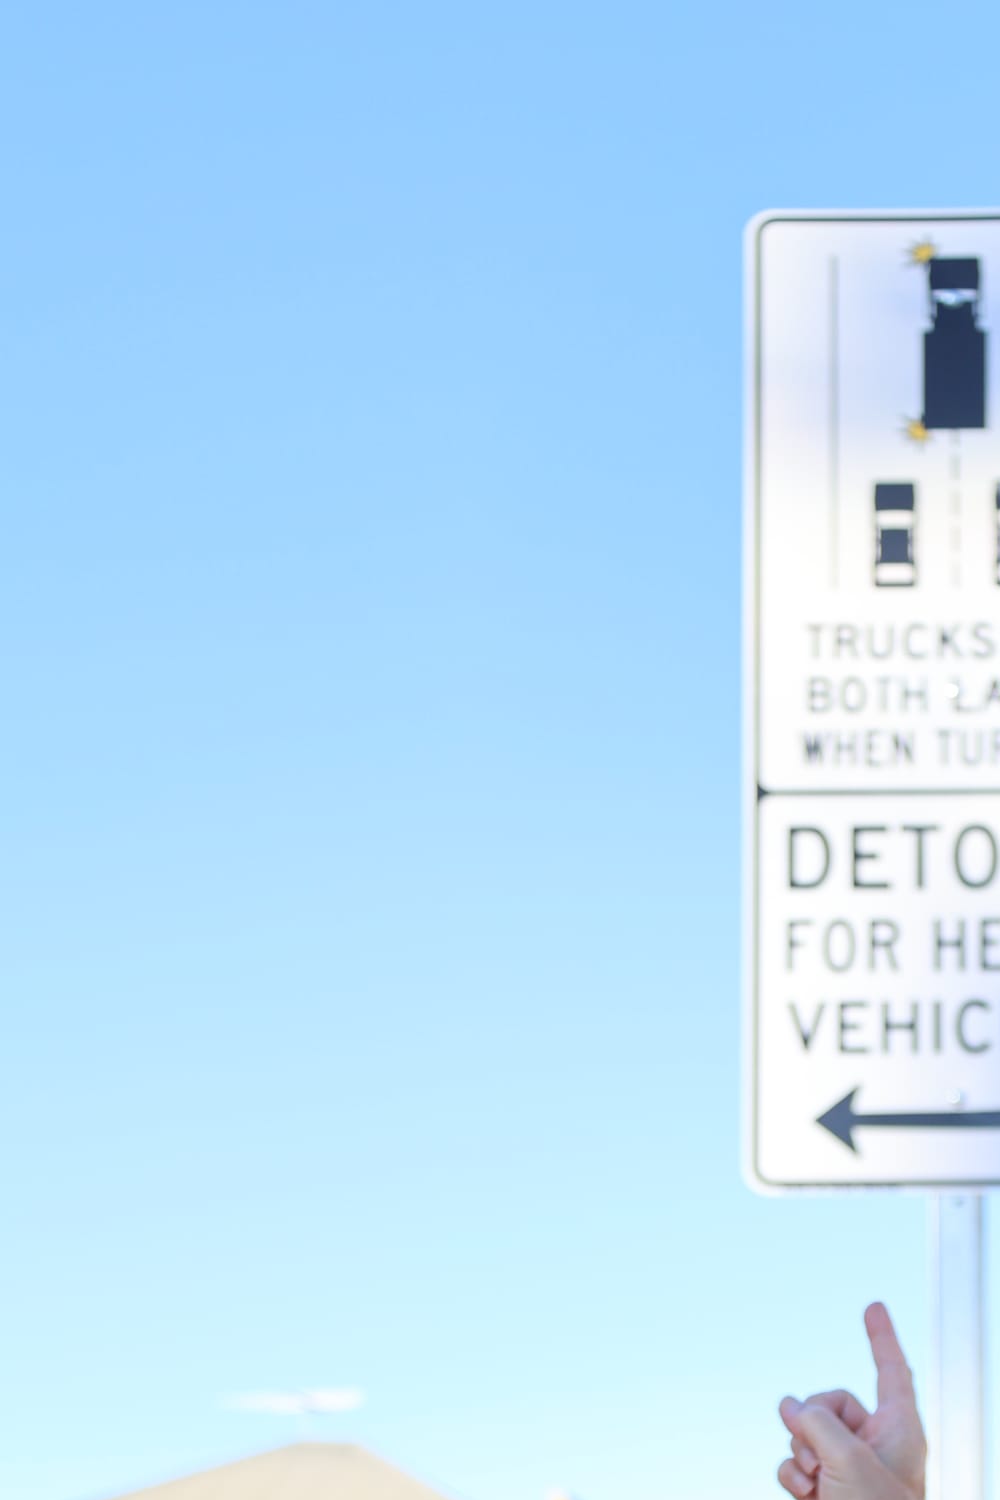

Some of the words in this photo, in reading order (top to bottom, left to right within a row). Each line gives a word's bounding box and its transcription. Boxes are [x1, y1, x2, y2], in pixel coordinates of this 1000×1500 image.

[807, 623, 996, 661] TRUCKS
[808, 676, 928, 712] BOTH
[802, 729, 914, 766] WHEN
[785, 917, 900, 972] FOR
